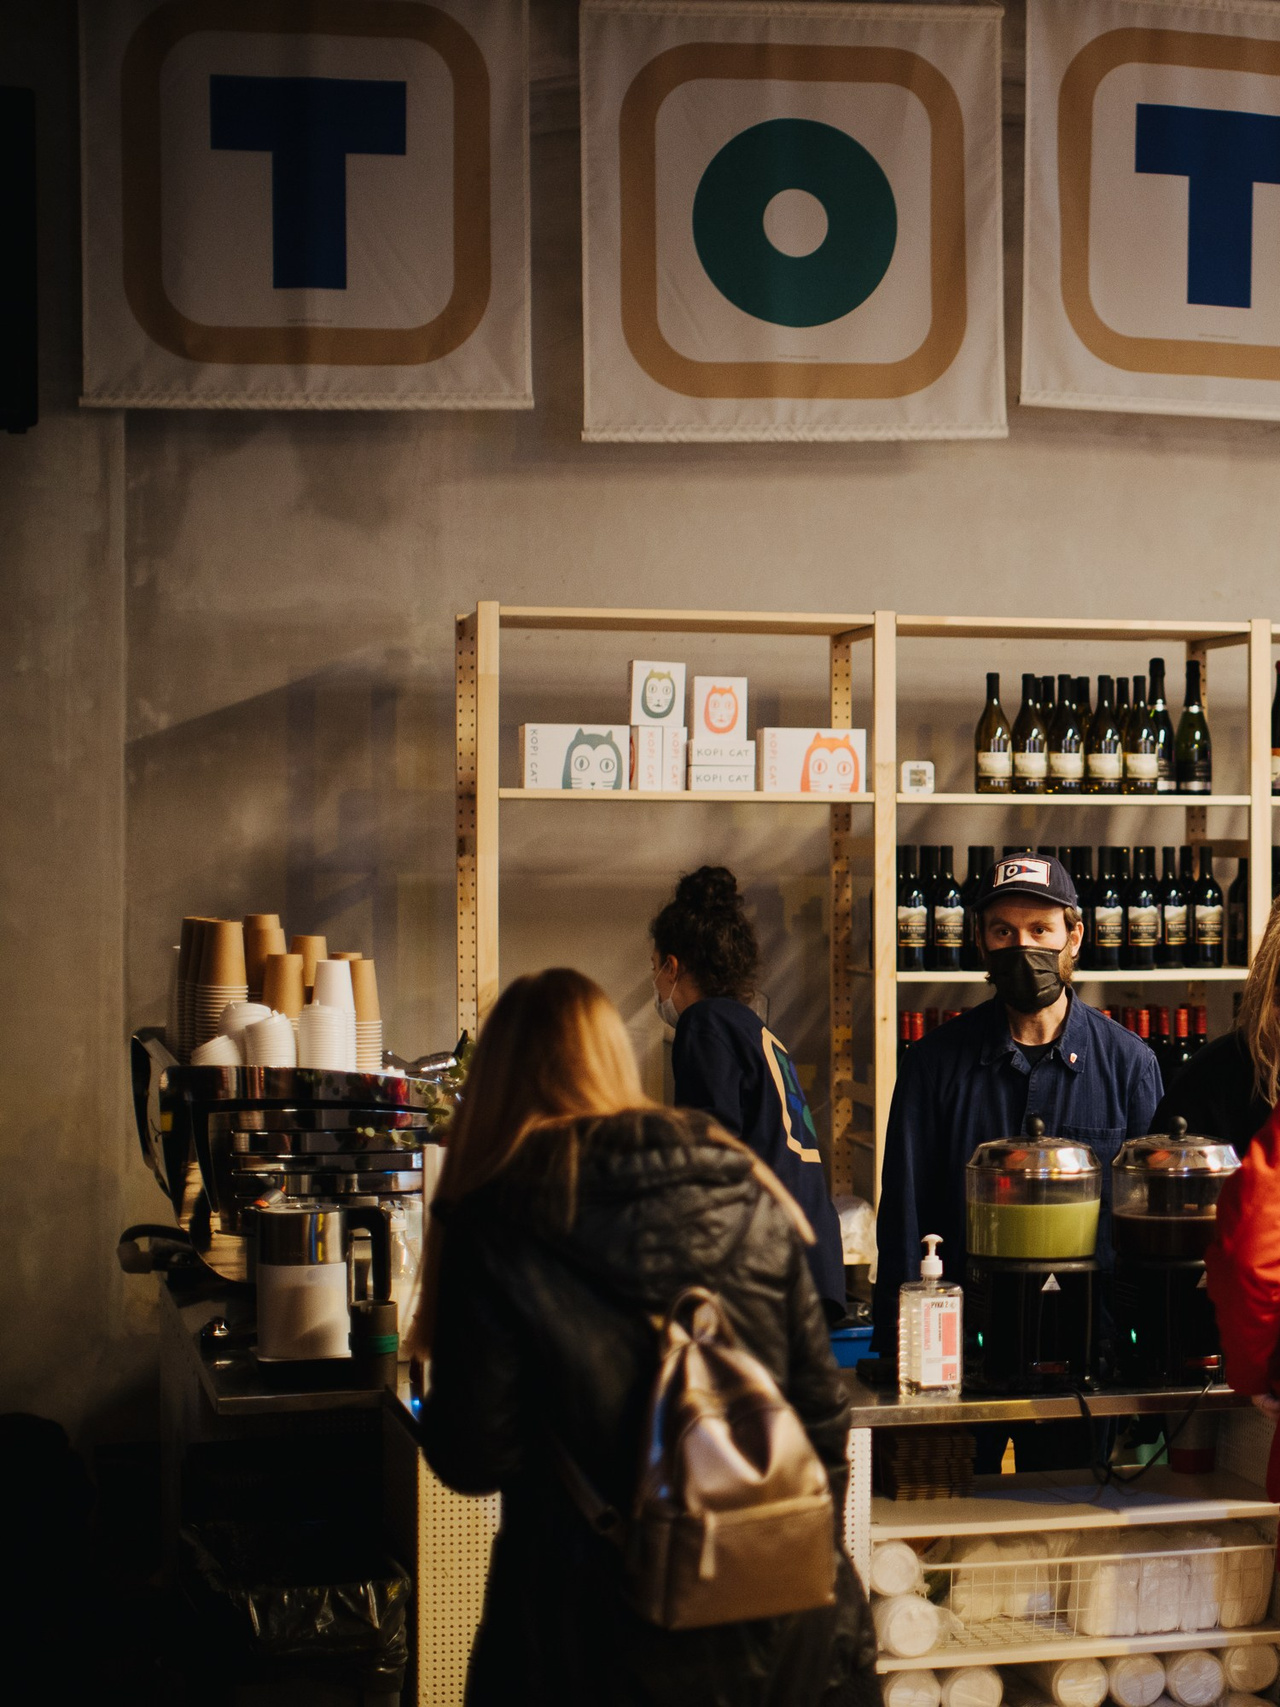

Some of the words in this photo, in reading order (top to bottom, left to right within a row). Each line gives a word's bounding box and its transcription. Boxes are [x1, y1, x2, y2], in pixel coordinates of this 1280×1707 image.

[210, 75, 406, 289] T
[692, 117, 897, 328] O
[530, 729, 538, 756] KOPI
[696, 748, 723, 757] KOPI
[728, 748, 750, 757] CAT
[530, 762, 538, 784] CAT
[695, 773, 722, 783] KOPI
[728, 773, 749, 783] CAT
